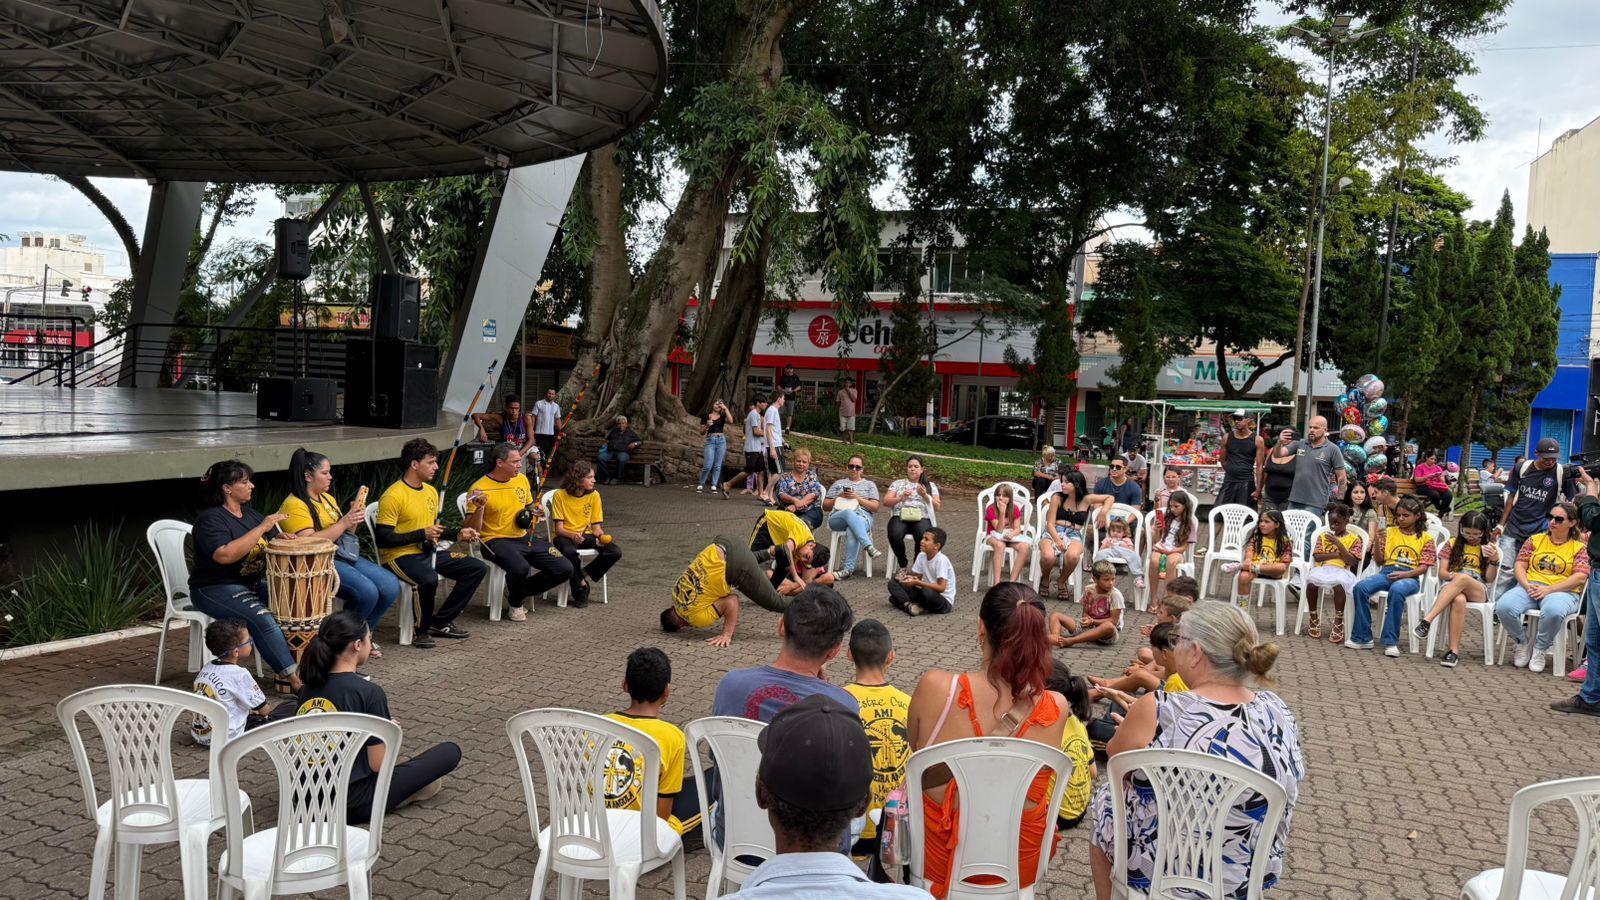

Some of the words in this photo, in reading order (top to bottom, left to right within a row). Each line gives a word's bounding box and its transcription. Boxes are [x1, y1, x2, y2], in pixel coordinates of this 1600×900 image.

[1194, 360, 1252, 381] Mtri
[1520, 485, 1548, 499] QATAR
[311, 699, 325, 707] AMI
[890, 697, 908, 711] Cuc
[874, 708, 893, 719] AMI
